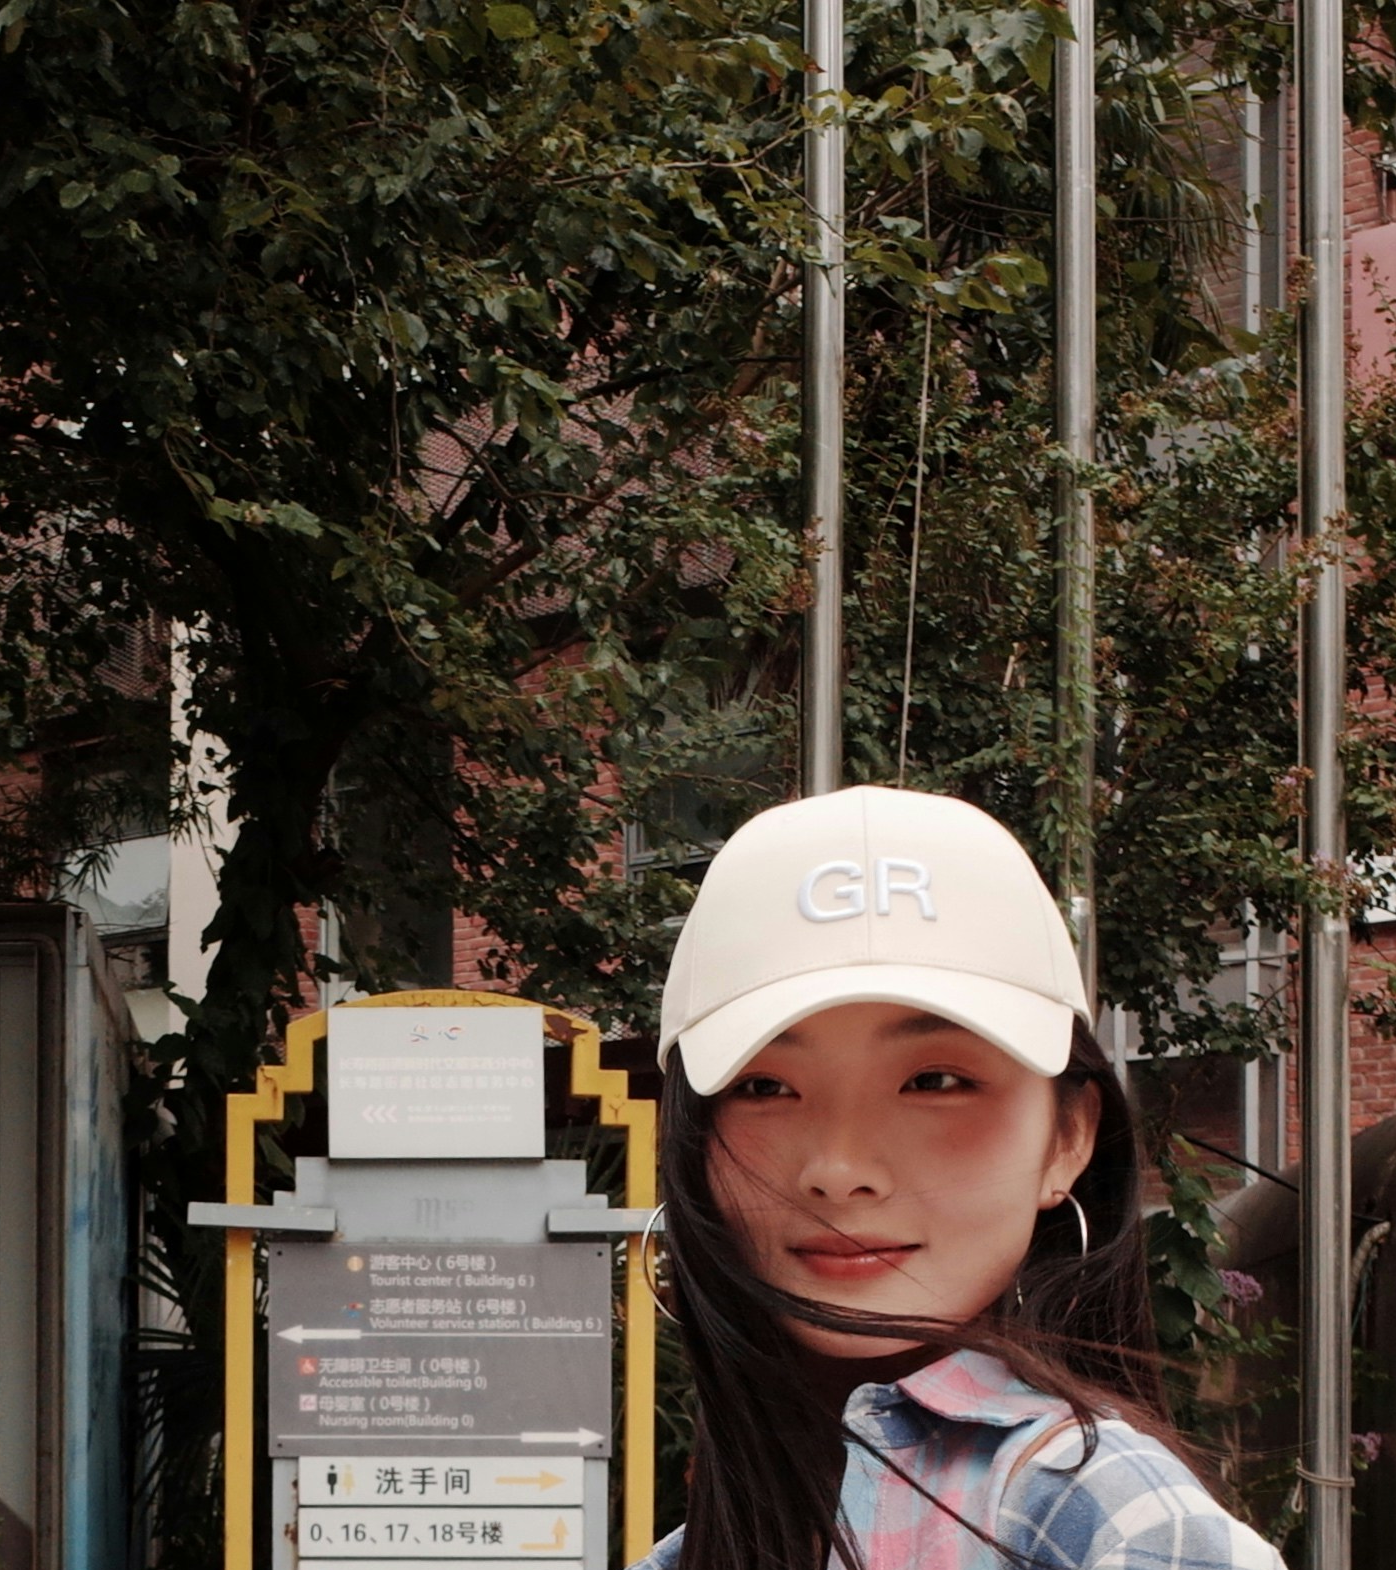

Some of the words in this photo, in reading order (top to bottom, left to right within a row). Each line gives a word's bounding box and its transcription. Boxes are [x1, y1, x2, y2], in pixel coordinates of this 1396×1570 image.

[797, 857, 937, 923] GR
[369, 1274, 412, 1287] Tourist
[413, 1275, 453, 1287] center
[369, 1317, 431, 1330] Volunteer
[432, 1317, 476, 1330] service
[477, 1317, 520, 1330] station
[319, 1375, 383, 1389] Accessible
[319, 1414, 368, 1428] Nursing
[375, 1466, 472, 1496] 洗手间
